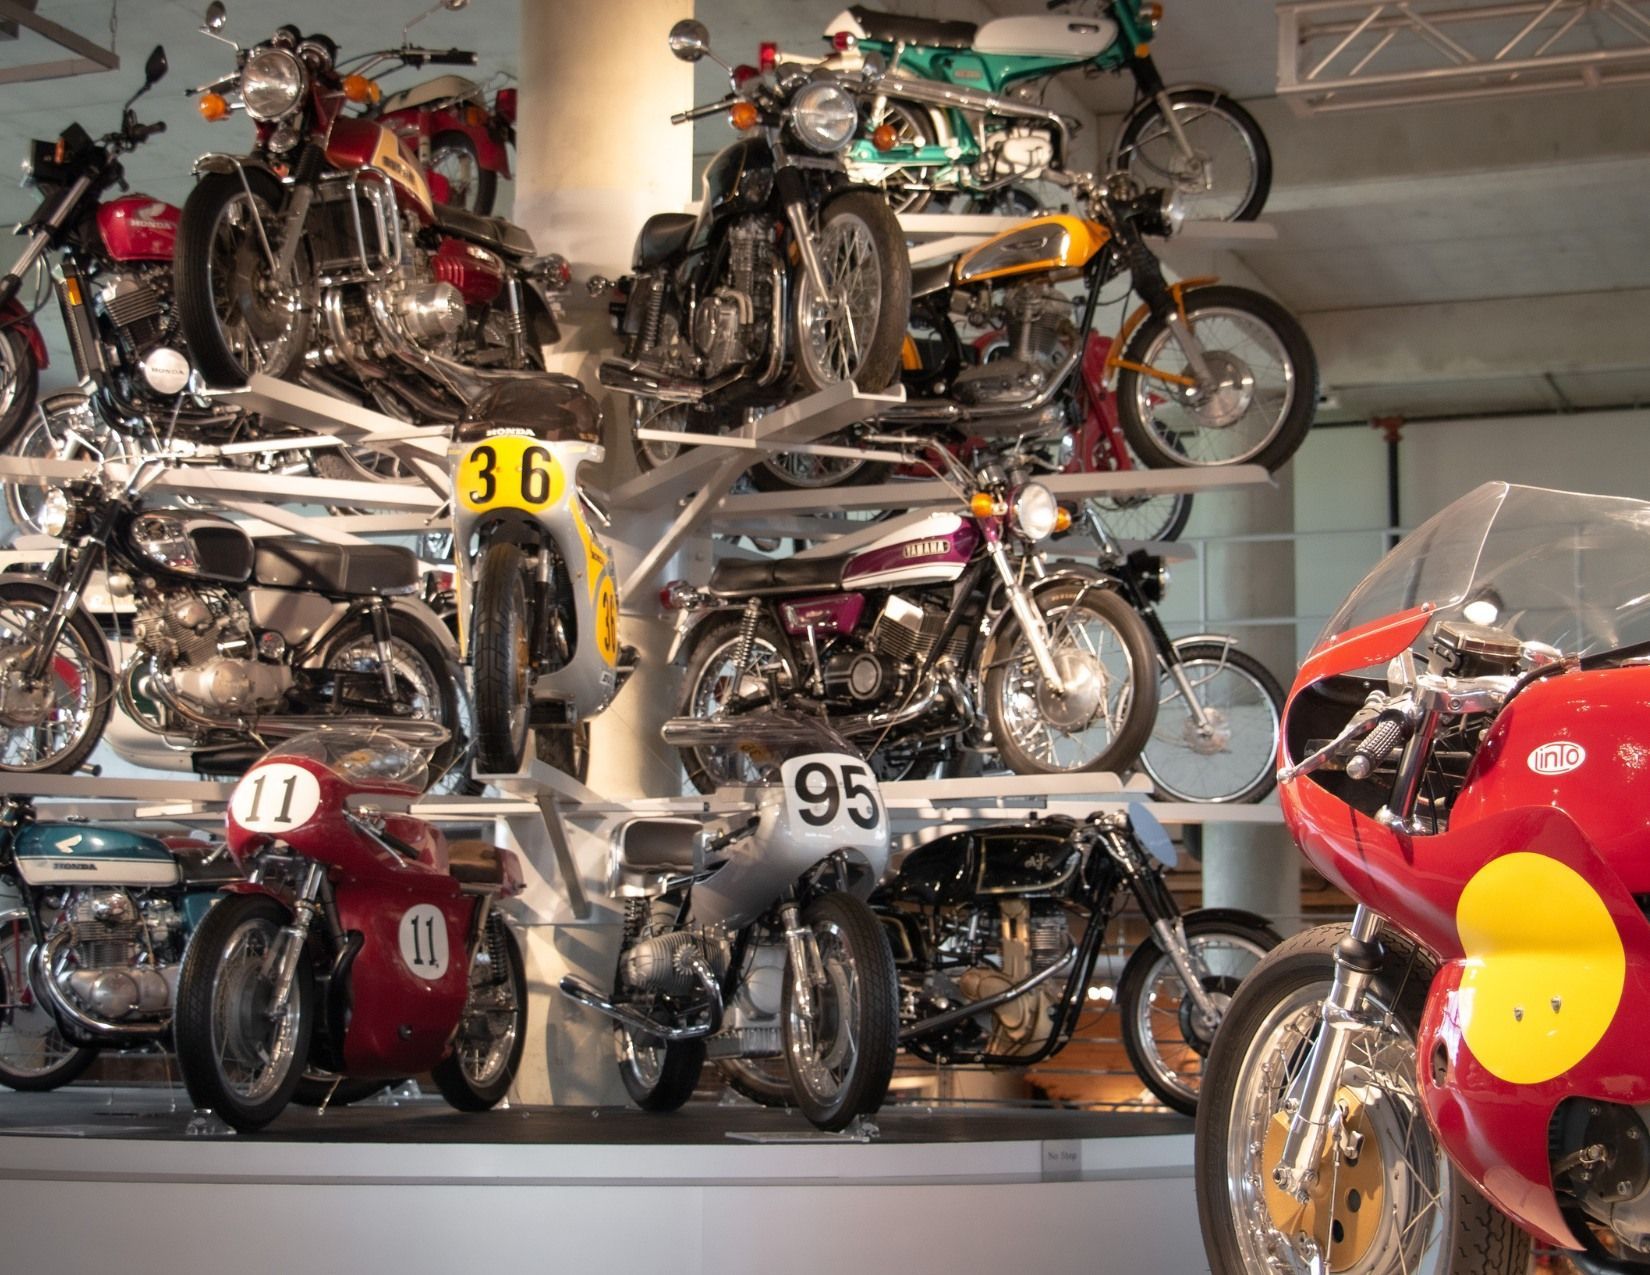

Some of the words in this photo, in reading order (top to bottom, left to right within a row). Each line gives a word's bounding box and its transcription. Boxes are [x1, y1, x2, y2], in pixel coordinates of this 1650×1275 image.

[486, 428, 535, 437] HONDA
[469, 446, 552, 504] 36
[245, 775, 298, 823] 11
[795, 762, 880, 830] 95
[53, 863, 98, 871] HONDA
[411, 915, 437, 966] 11
